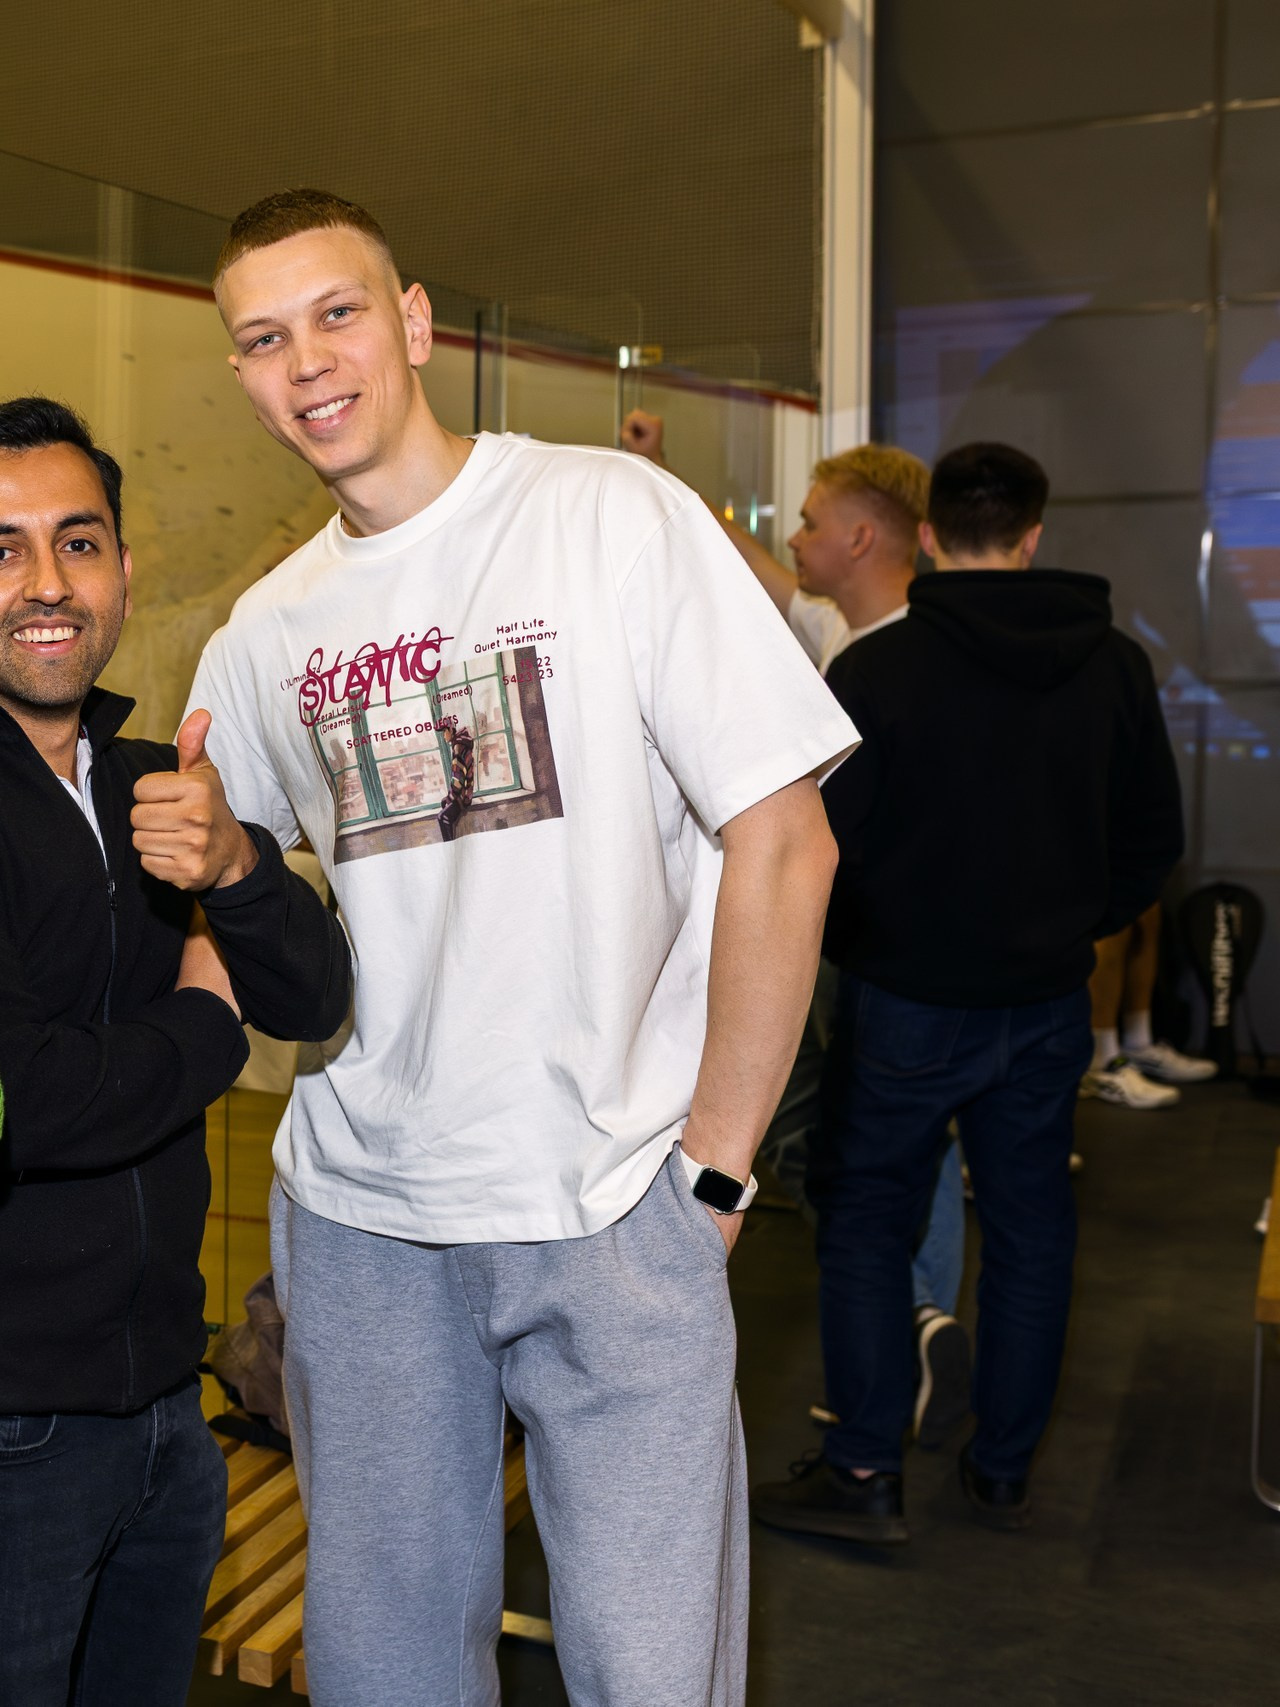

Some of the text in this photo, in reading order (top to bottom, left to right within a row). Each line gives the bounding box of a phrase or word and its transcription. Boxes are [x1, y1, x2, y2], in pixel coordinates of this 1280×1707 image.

[496, 622, 518, 635] Half
[474, 631, 558, 654] Quiet Harmony
[432, 684, 473, 707] (Dreamed)
[319, 713, 362, 736] (Dreamed)
[346, 715, 459, 749] SCATTERED OBJECTS
